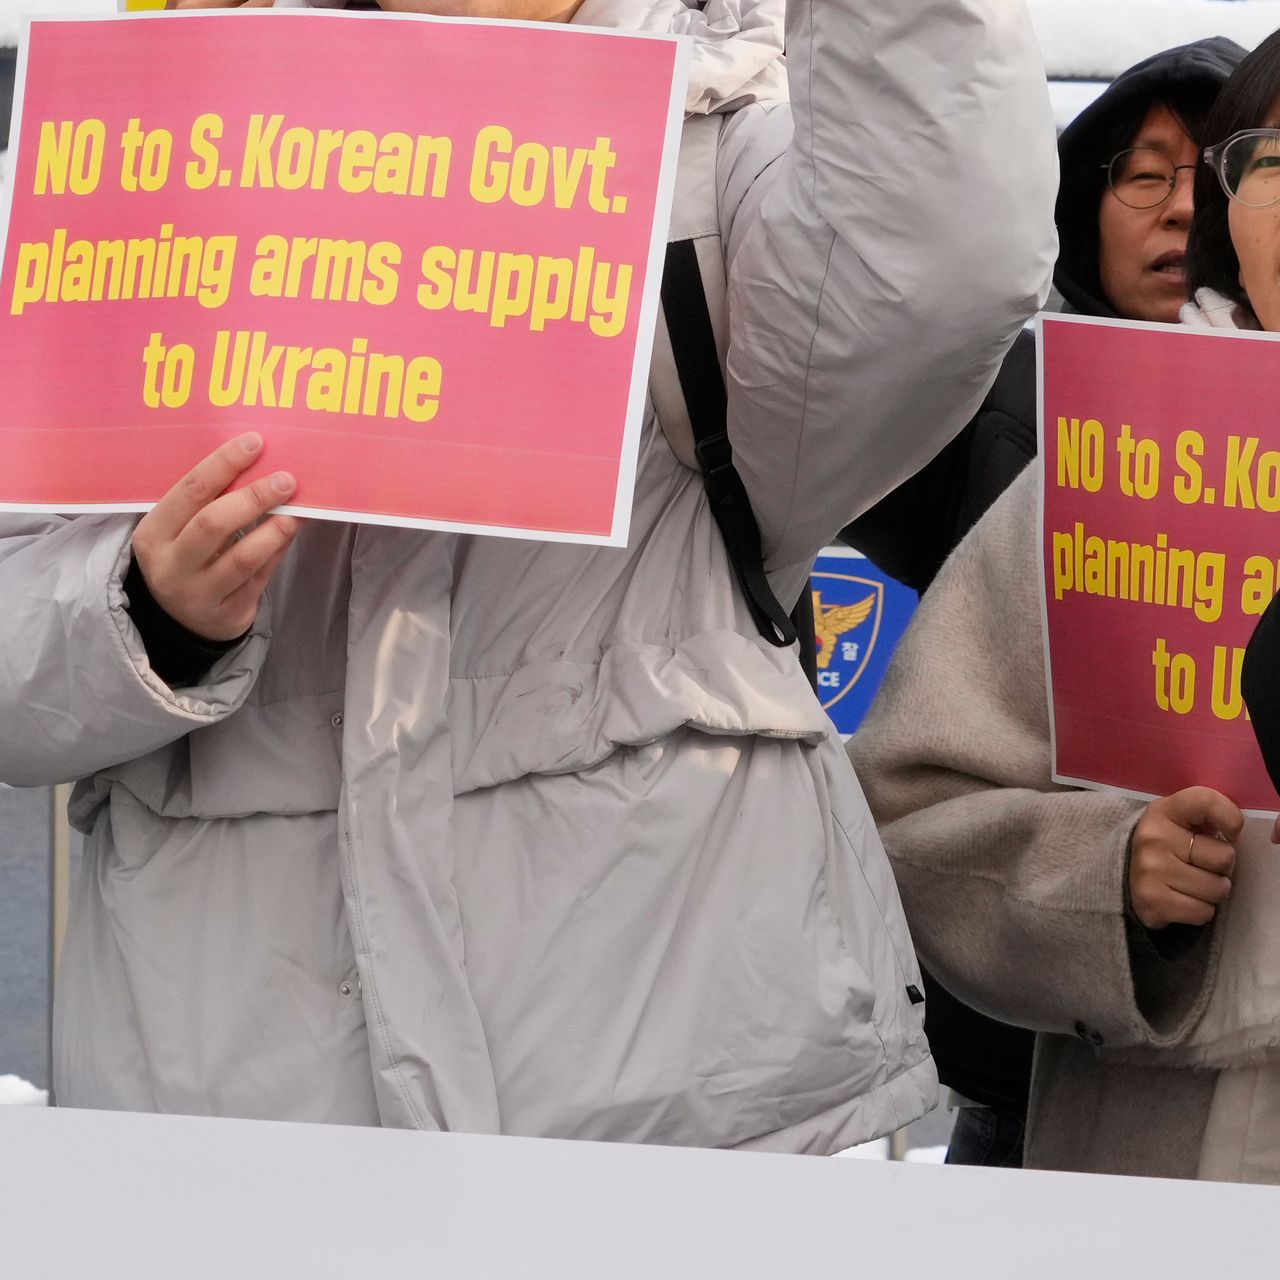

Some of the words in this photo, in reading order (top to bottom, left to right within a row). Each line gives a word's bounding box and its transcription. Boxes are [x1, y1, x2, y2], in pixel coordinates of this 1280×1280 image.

[35, 119, 105, 195] NO
[121, 120, 172, 191] to
[472, 128, 625, 211] Govt.
[12, 224, 237, 315] planning
[252, 236, 400, 304] arms
[419, 246, 632, 336] supply
[144, 333, 195, 408] to
[209, 330, 442, 422] Ukraine
[1058, 417, 1103, 492] NO
[1117, 425, 1159, 499] to
[1054, 523, 1225, 622] planning
[1153, 639, 1195, 713] to
